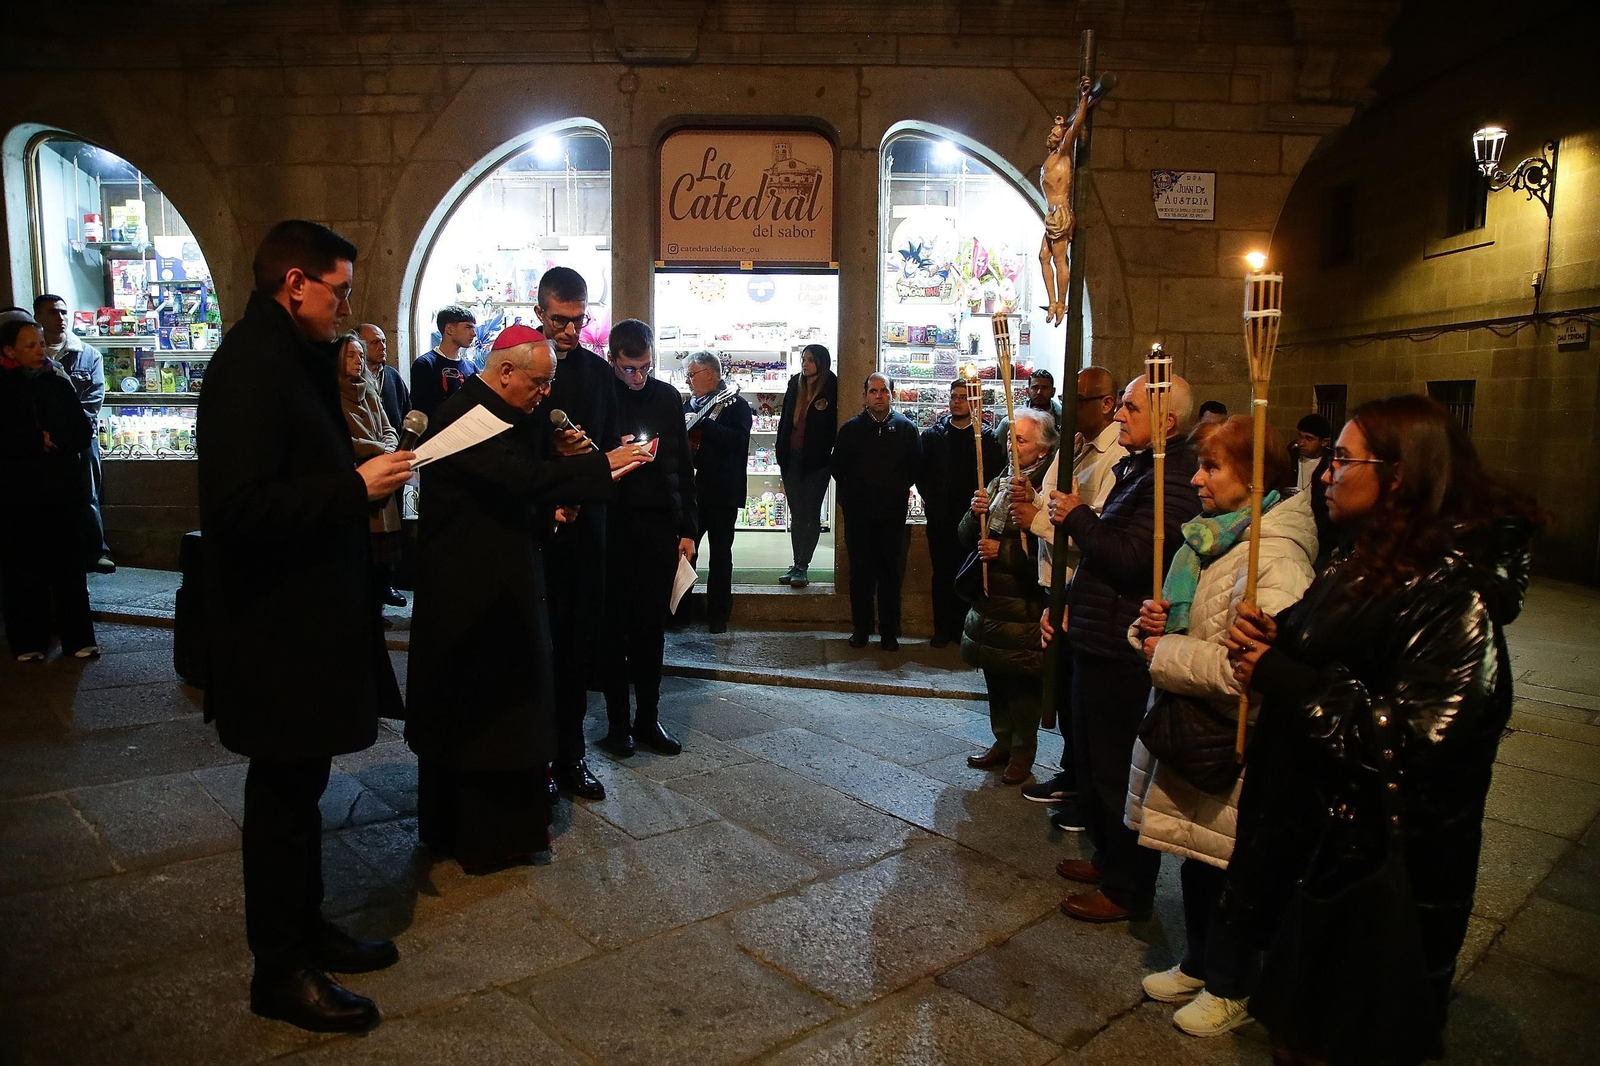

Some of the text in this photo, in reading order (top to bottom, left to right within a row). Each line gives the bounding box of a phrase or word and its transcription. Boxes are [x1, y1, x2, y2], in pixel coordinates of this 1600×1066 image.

[696, 147, 736, 182] La
[1176, 184, 1194, 194] JUAN
[669, 172, 824, 221] Catedral
[1164, 195, 1209, 206] AUSTRIA
[752, 224, 816, 238] del sabor
[680, 245, 760, 254] catedraldelsabor_ou
[896, 283, 925, 297] DRAGON
